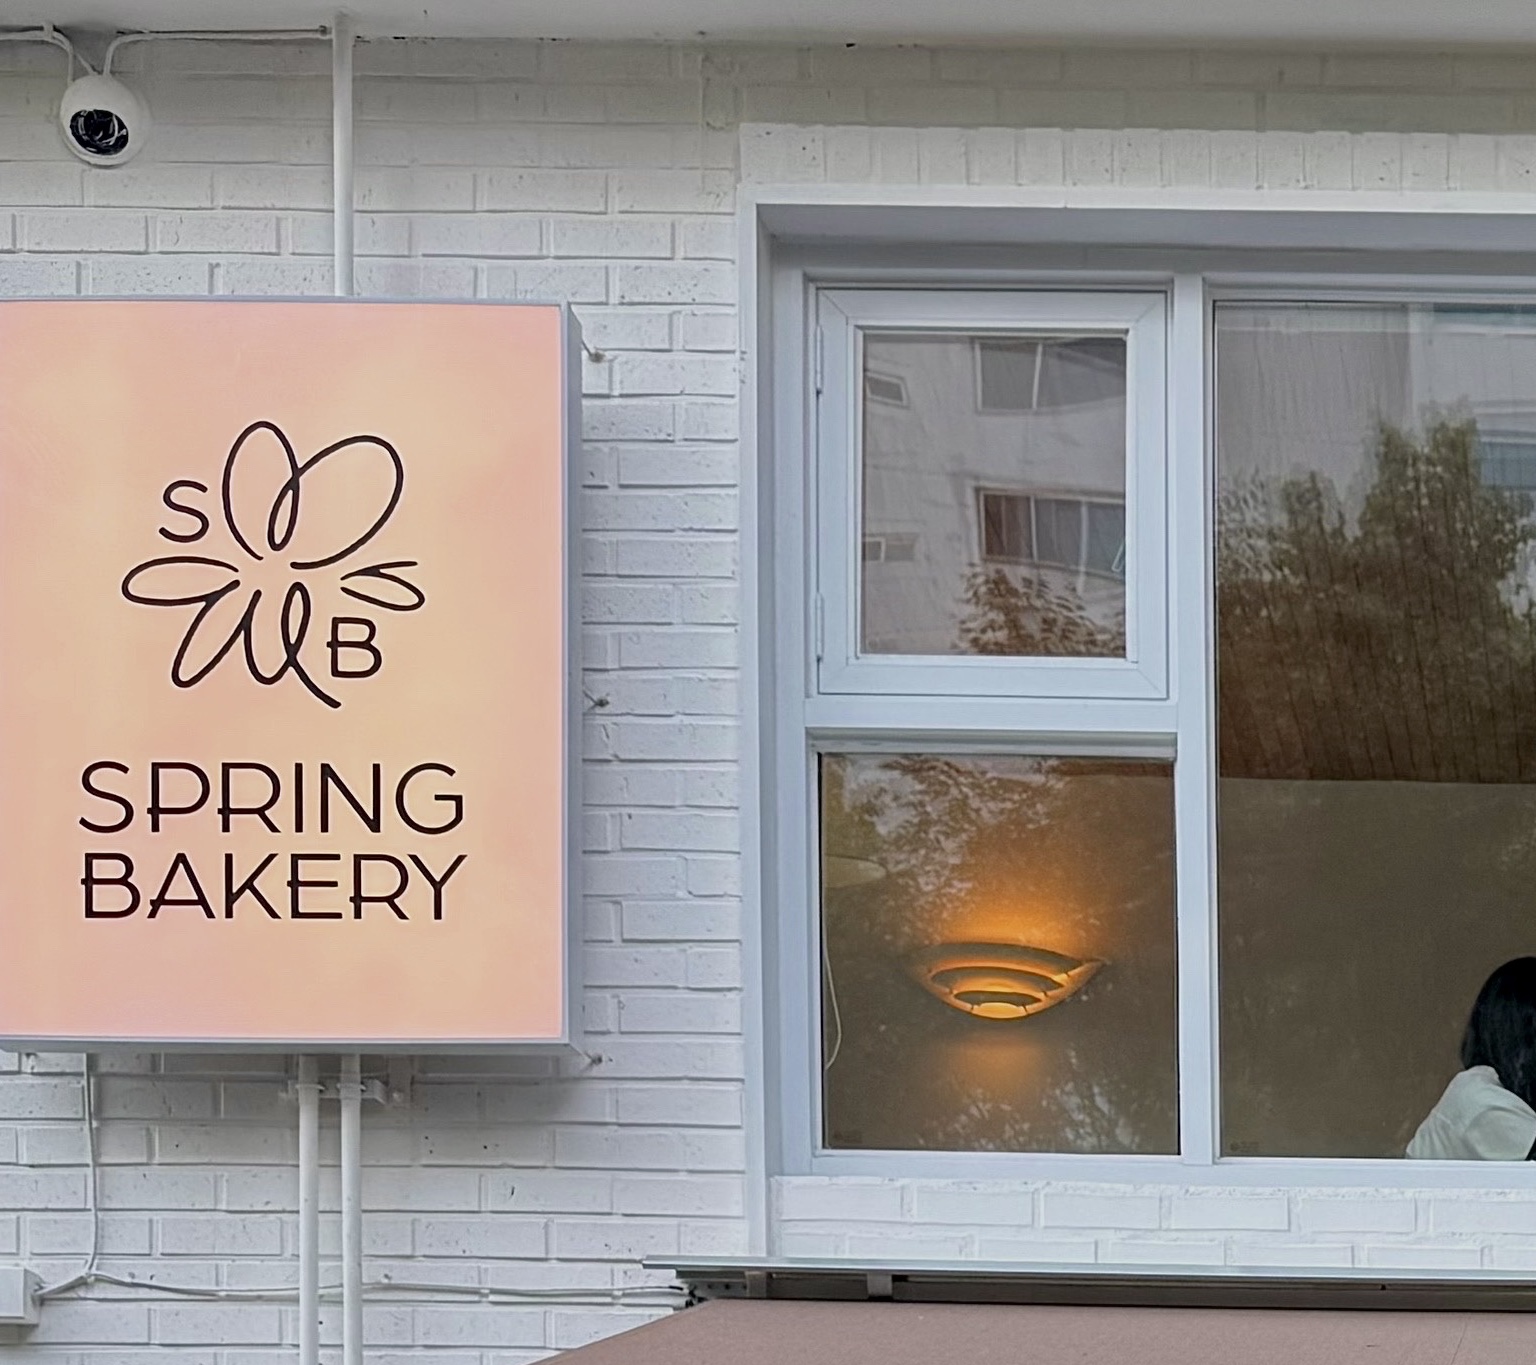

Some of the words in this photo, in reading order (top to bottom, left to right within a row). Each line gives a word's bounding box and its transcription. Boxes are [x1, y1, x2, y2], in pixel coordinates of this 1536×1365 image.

[158, 479, 210, 544] S
[326, 616, 383, 679] B
[78, 760, 464, 835] SPRING
[80, 852, 468, 921] BAKERY
